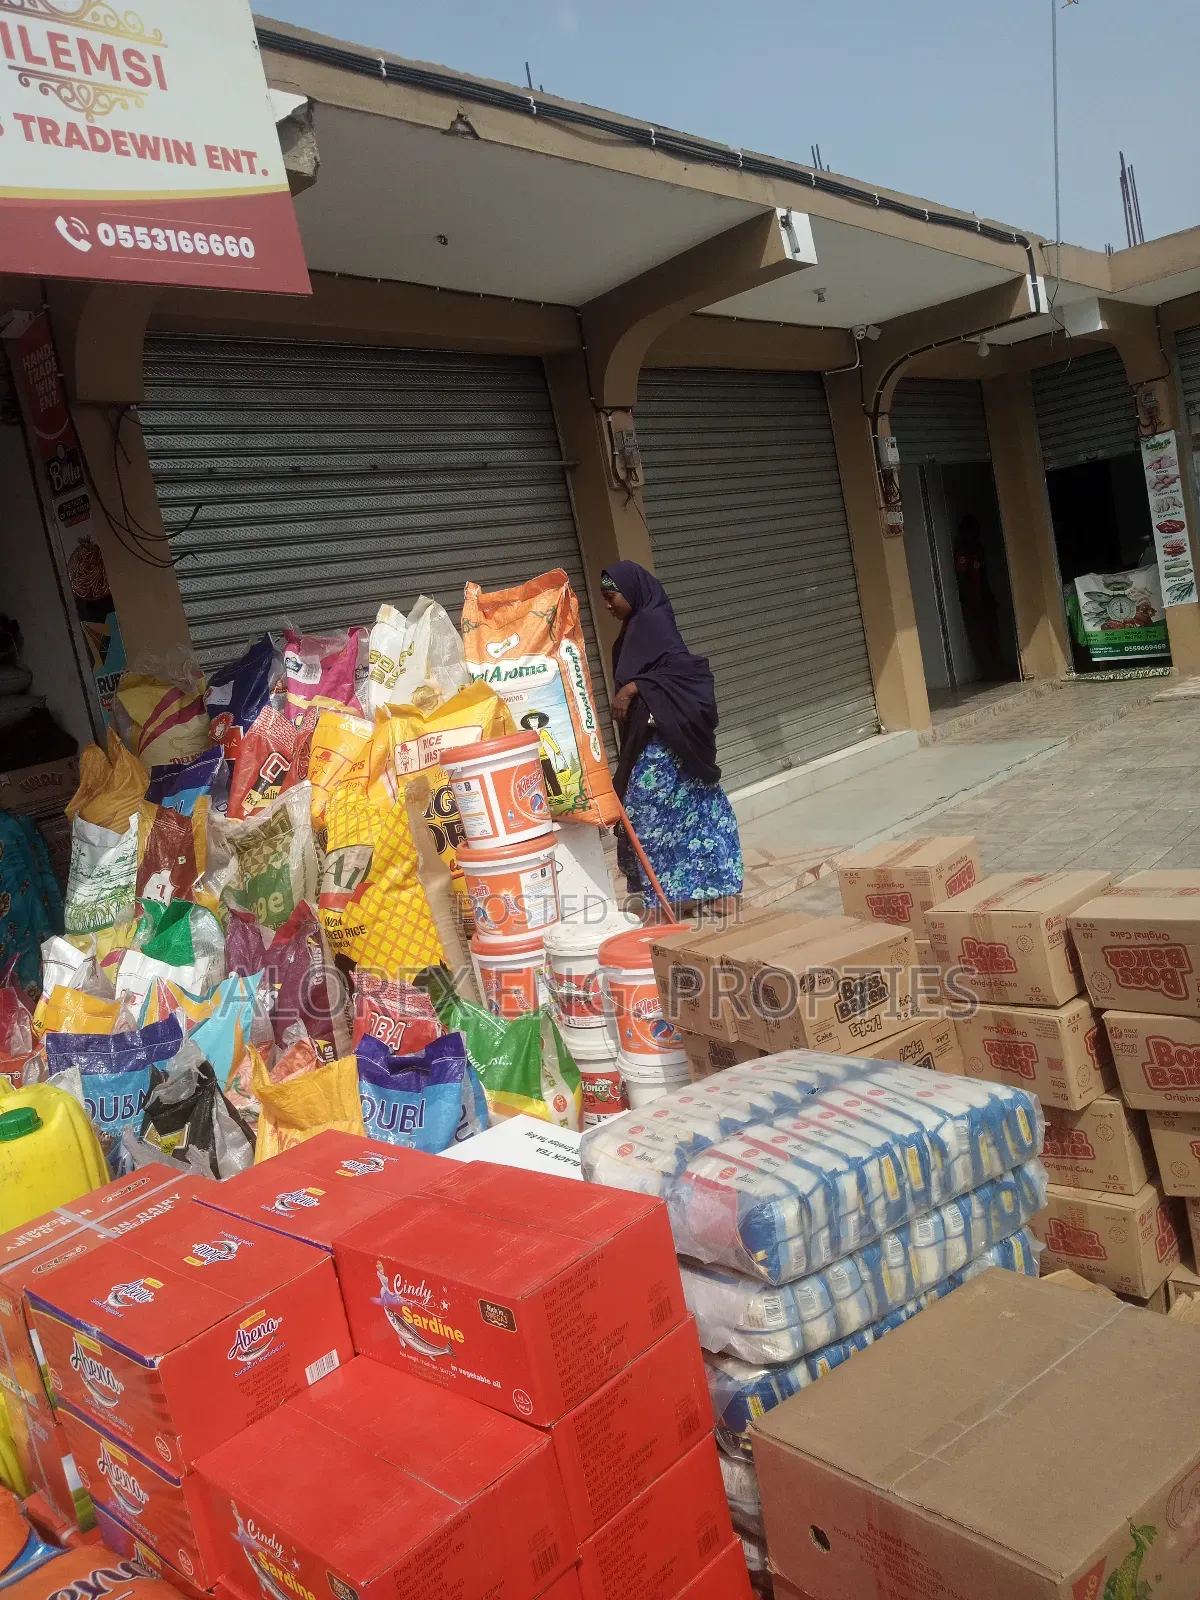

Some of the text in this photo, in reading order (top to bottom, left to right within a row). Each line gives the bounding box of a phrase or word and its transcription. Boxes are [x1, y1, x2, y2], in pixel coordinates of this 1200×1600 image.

[13, 112, 198, 167] TRADEWIN
[204, 145, 270, 177] ENT.
[97, 222, 256, 259] 0553166660
[35, 377, 57, 398] WIN
[50, 461, 82, 491] Bella
[489, 663, 548, 683] Aroma
[565, 645, 587, 690] Aroma
[345, 925, 367, 938] RICE
[1109, 931, 1170, 941] Original Cake
[1000, 980, 1018, 988] Cake
[815, 1030, 834, 1043] Cake
[848, 1014, 883, 1038] Enjoy!
[535, 1147, 553, 1157] TEA
[1074, 1165, 1095, 1175] Cake
[393, 1273, 434, 1305] Cindy
[401, 1305, 466, 1344] Sardine
[227, 1317, 279, 1360] Abena
[70, 1336, 120, 1395] Abena
[450, 1363, 458, 1372] in
[458, 1366, 491, 1385] vegetable
[247, 1518, 285, 1558] Cindy
[867, 1520, 903, 1547] Packed
[452, 1542, 465, 1555] 185
[257, 1550, 317, 1600] Sardine
